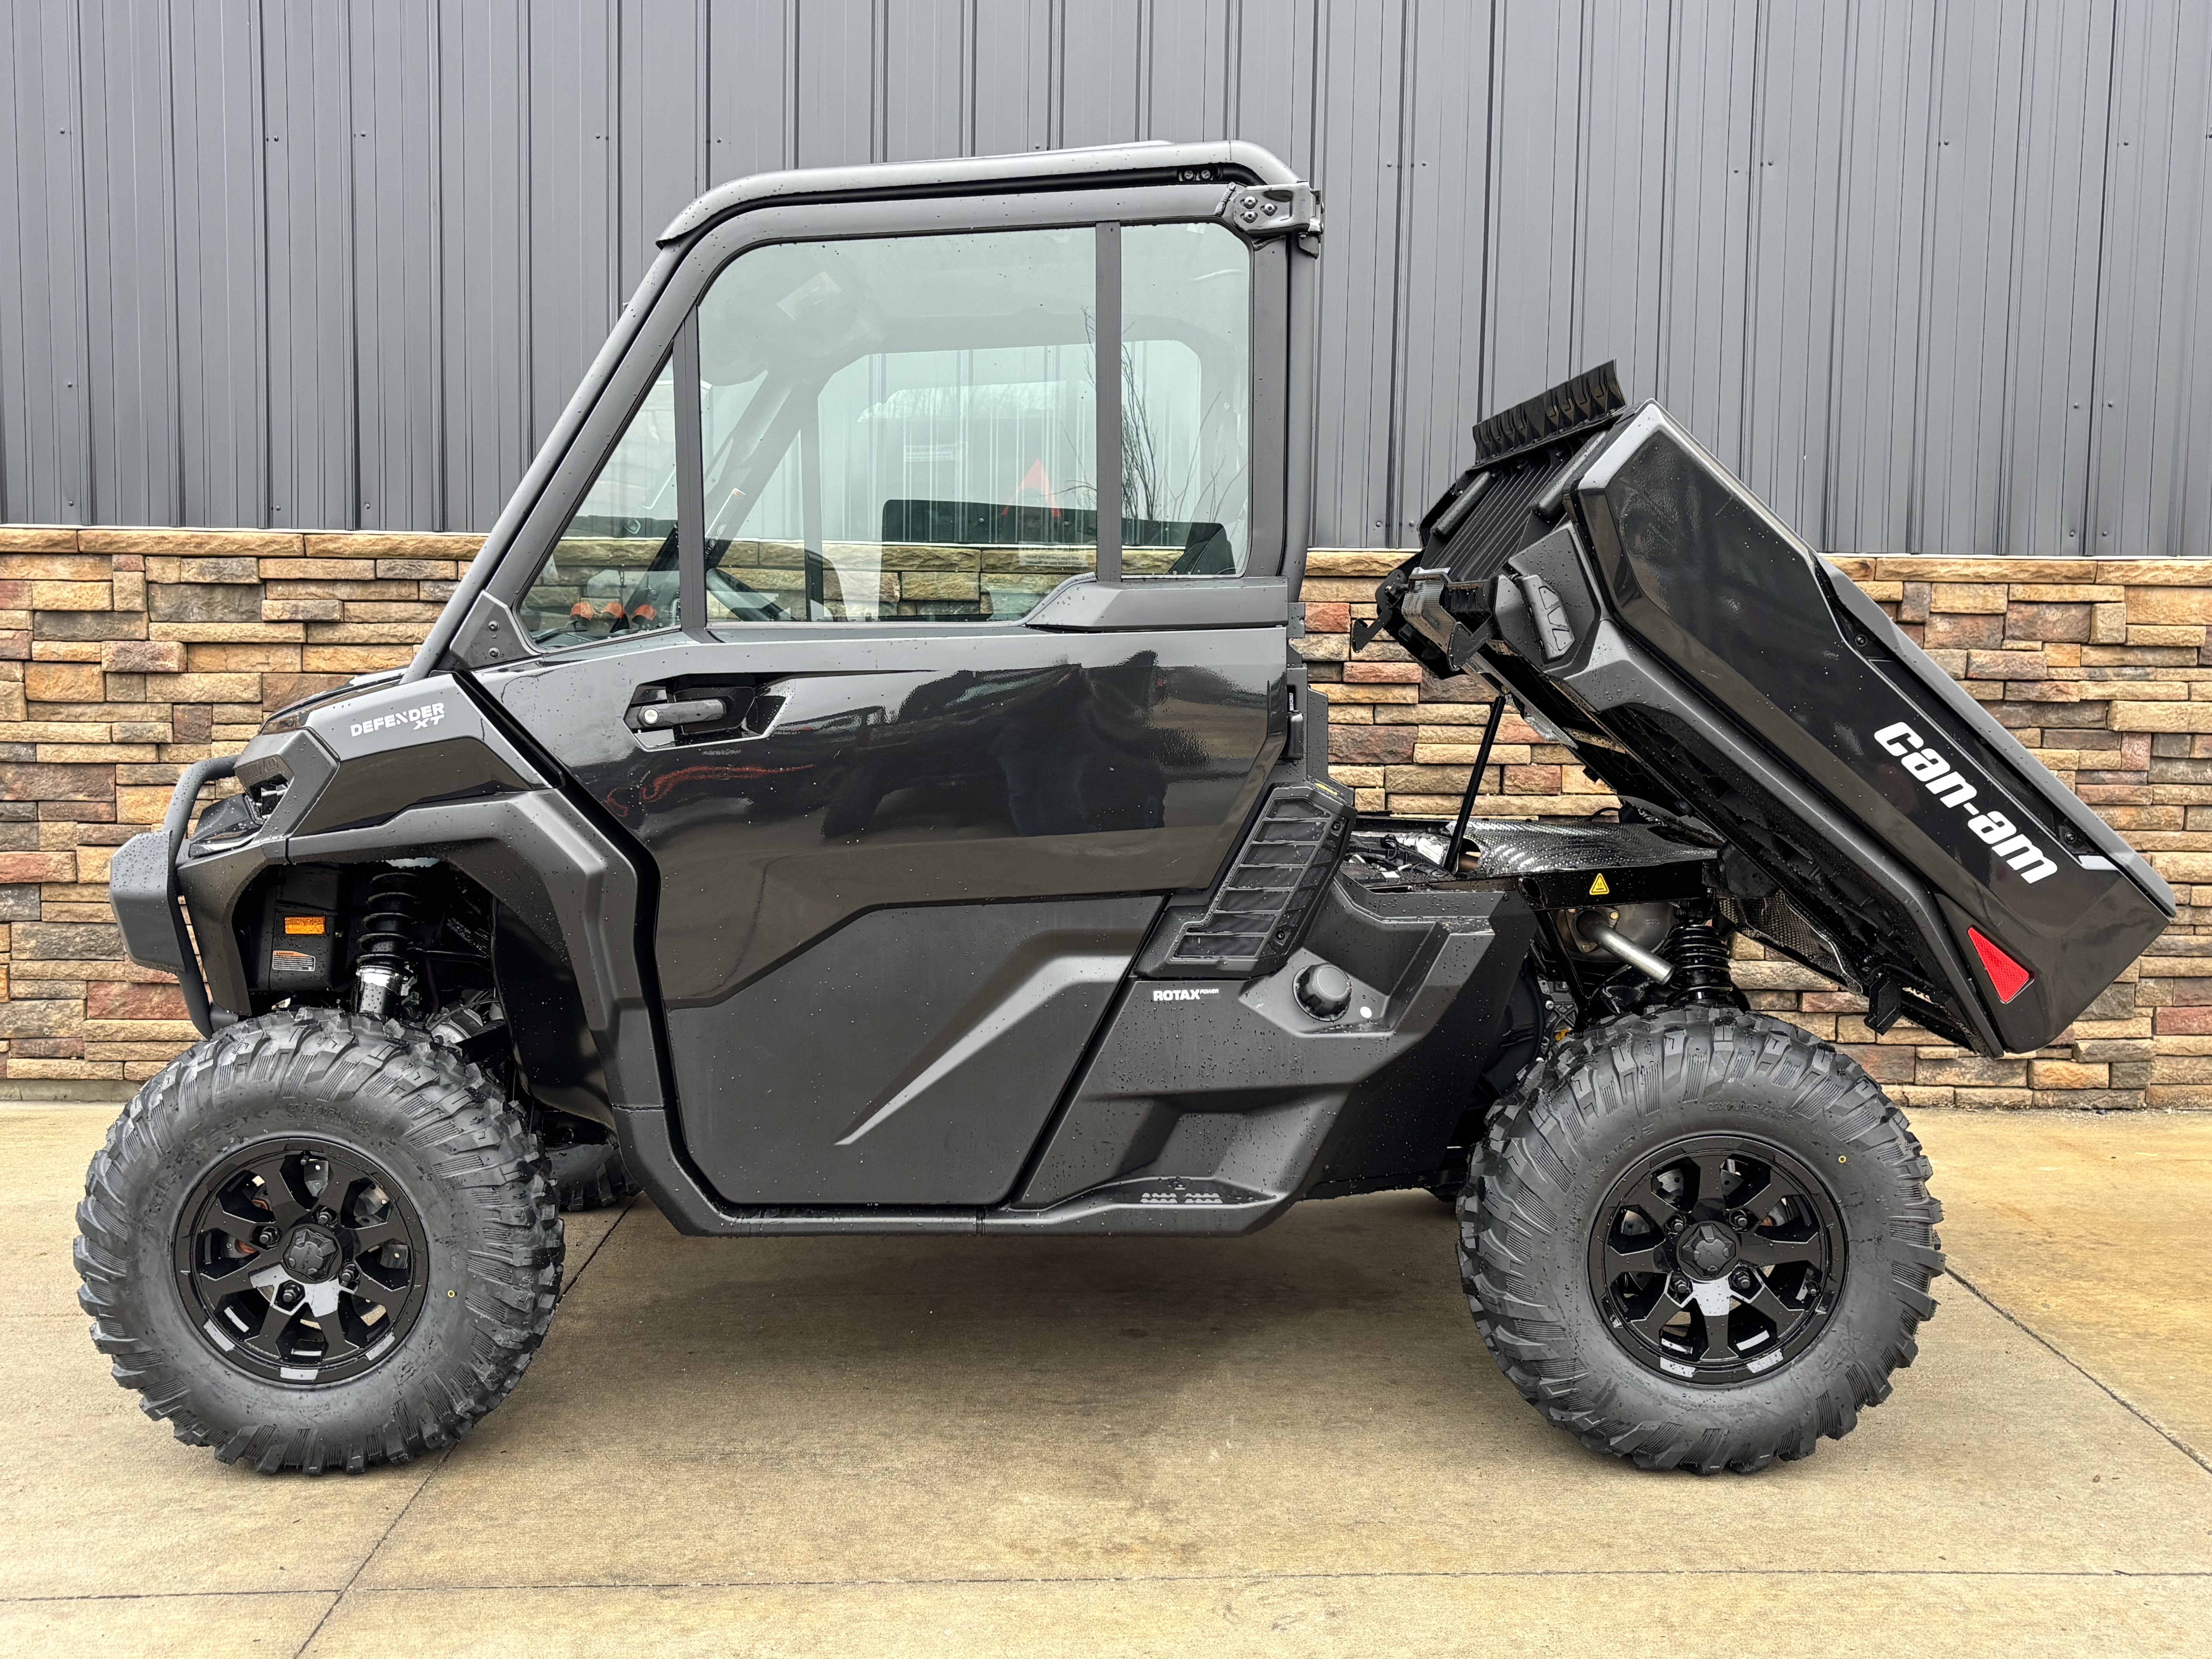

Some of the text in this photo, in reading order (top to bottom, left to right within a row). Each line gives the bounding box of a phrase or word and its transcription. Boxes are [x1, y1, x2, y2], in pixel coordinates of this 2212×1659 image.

[350, 702, 444, 737] DEFENDER
[413, 714, 445, 730] XT
[1874, 721, 2058, 884] can-am
[1153, 989, 1200, 1001] ROTAX
